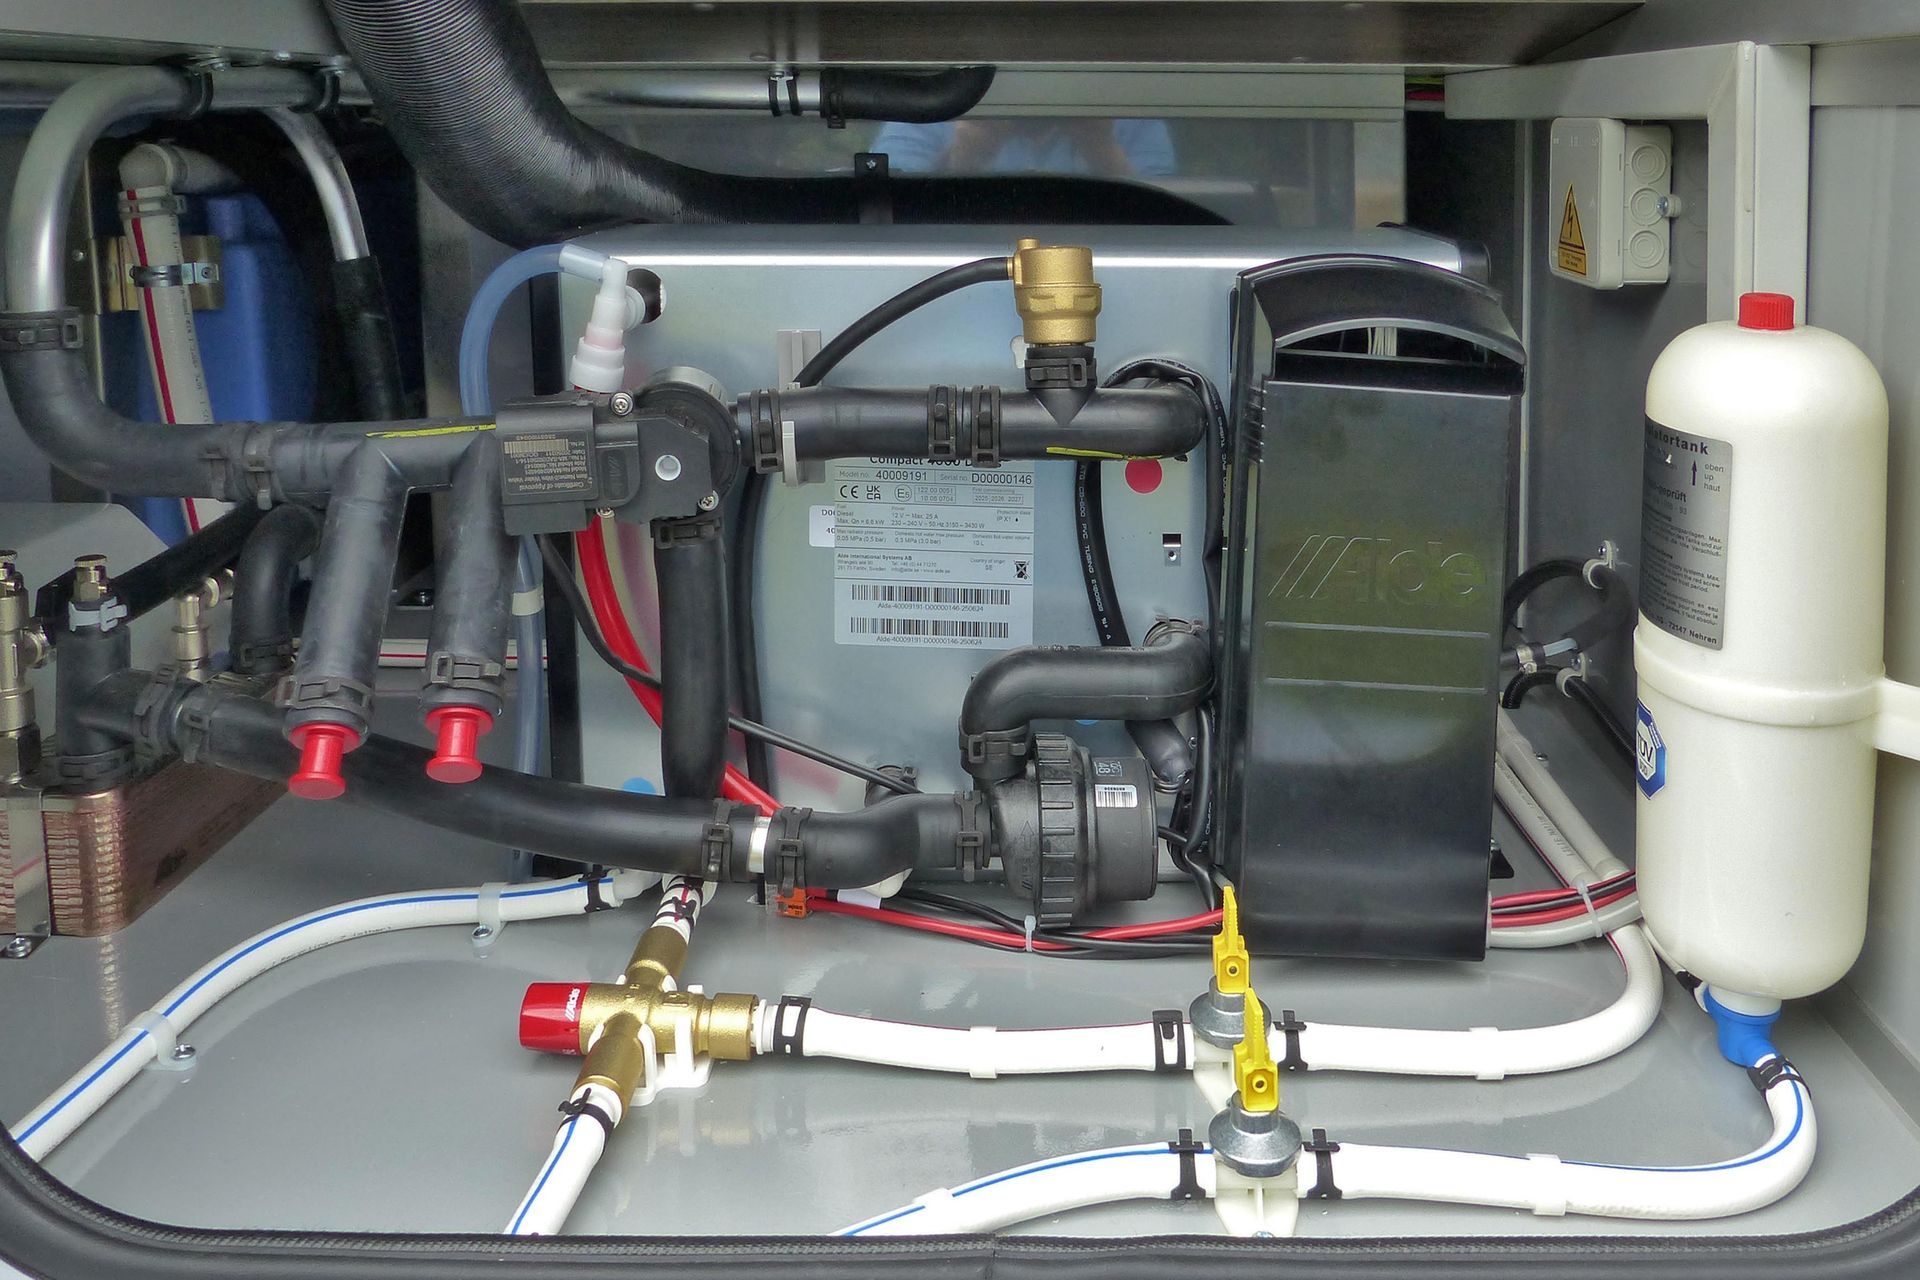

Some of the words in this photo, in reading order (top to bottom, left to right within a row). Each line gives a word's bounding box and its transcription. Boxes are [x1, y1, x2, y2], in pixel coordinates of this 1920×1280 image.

[869, 456, 923, 467] Compact
[1704, 463, 1724, 473] oben
[875, 469, 928, 481] 40009191
[971, 473, 1032, 485] D00000146
[1704, 474, 1714, 482] up
[1703, 482, 1721, 492] haut
[1689, 629, 1717, 644] Nehren
